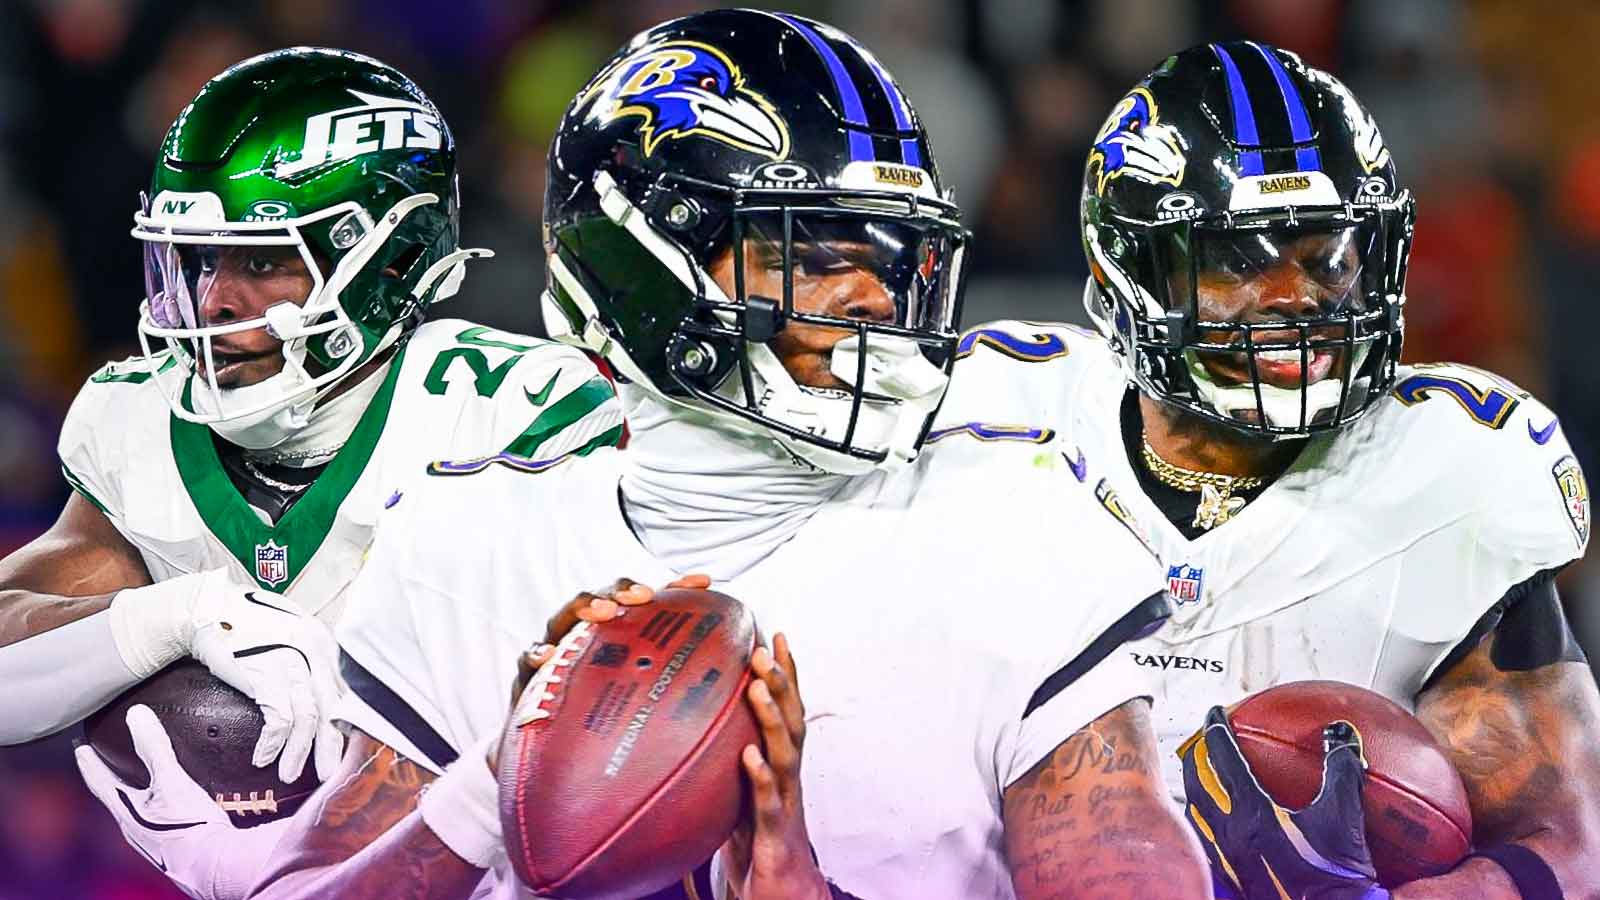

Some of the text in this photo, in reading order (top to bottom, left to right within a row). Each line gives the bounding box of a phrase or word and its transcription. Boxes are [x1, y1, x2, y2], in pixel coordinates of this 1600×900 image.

[616, 50, 697, 98] B
[274, 89, 443, 179] JETS
[874, 165, 923, 188] RAVENS
[1257, 175, 1312, 194] RAVENS
[161, 201, 195, 215] NY
[260, 561, 282, 579] NFL
[1169, 578, 1197, 600] NFL
[603, 703, 653, 778] NATIONAL
